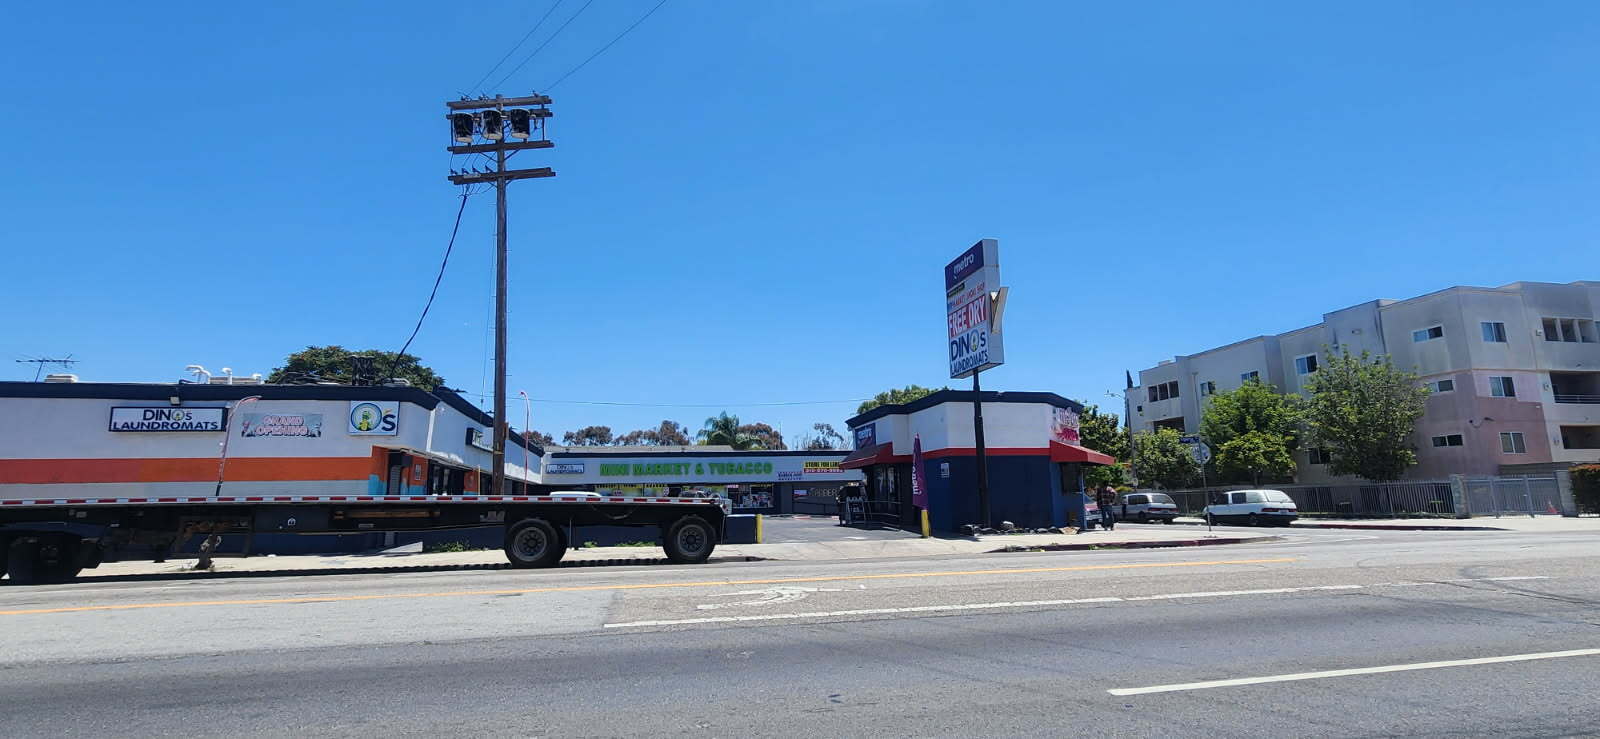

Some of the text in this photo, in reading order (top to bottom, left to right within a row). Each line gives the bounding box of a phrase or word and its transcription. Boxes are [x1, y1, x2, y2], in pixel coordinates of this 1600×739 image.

[949, 295, 985, 337] FREE DRY
[951, 351, 988, 376] LAUNDROMATS
[112, 421, 218, 430] LAUNDROMATS
[264, 415, 305, 426] GRAND
[255, 425, 309, 437] OPENING
[600, 463, 629, 475] MINI
[633, 463, 691, 475] MARKET
[695, 463, 705, 475] &
